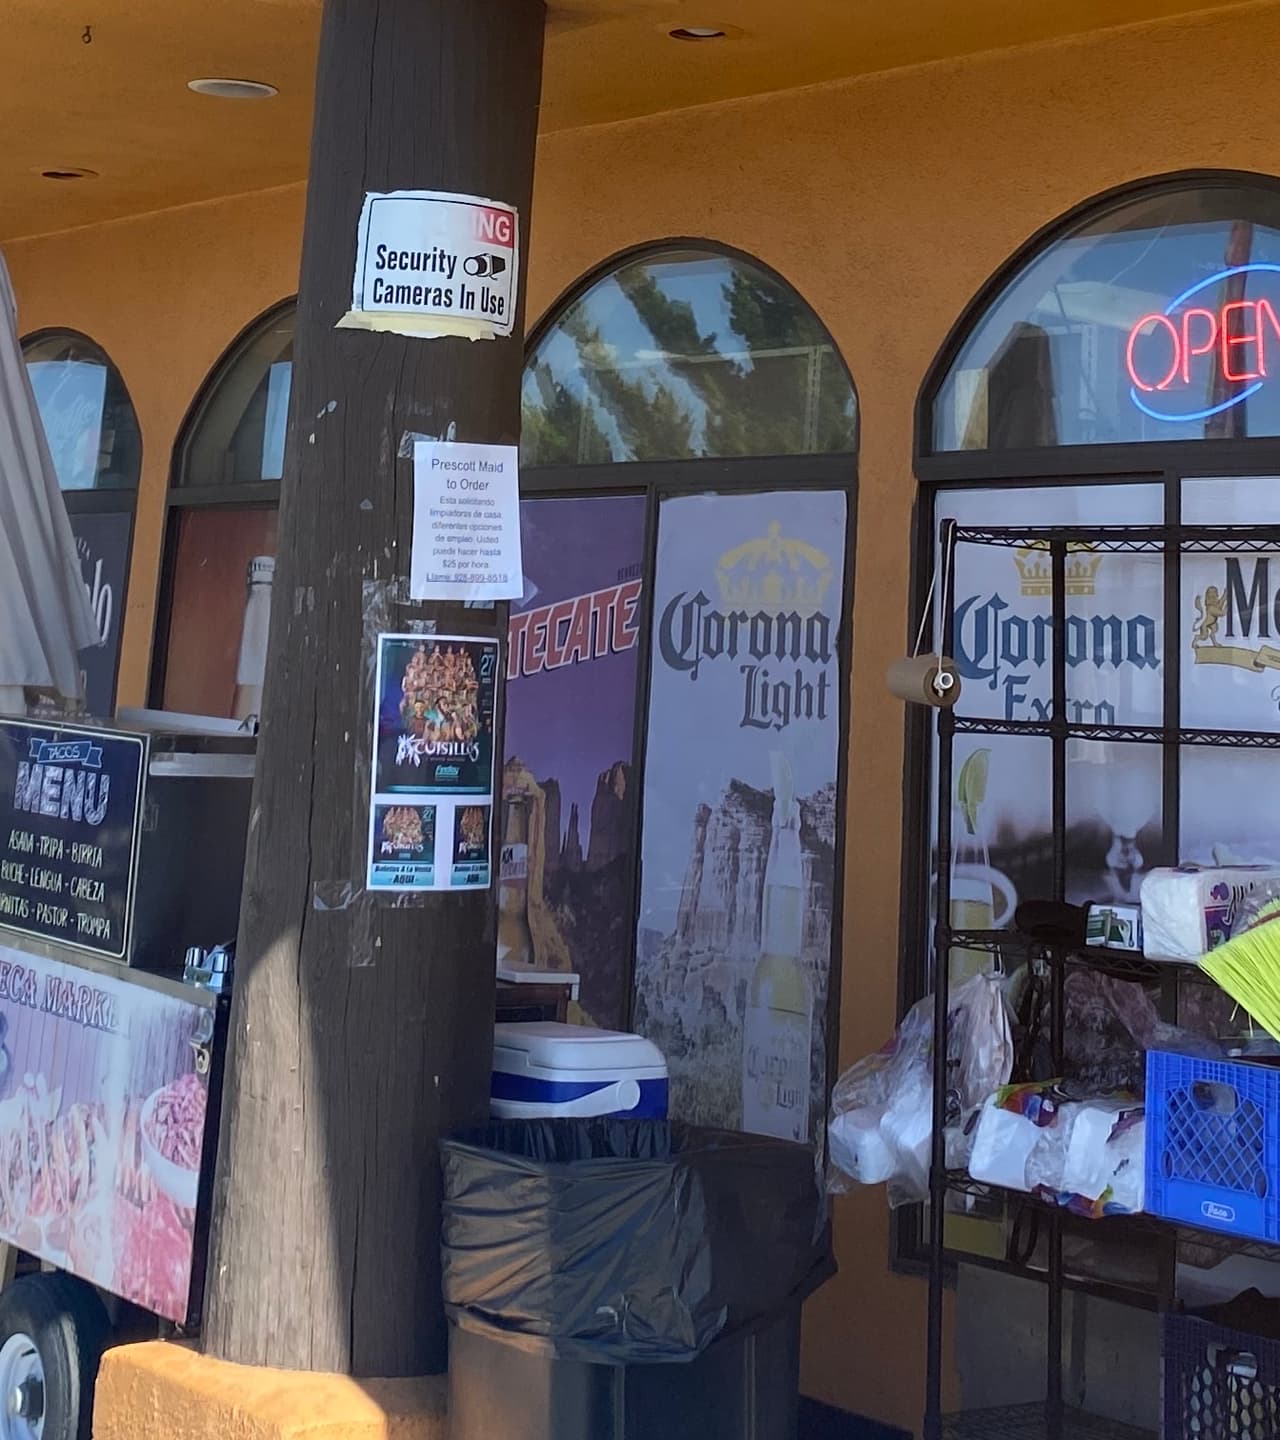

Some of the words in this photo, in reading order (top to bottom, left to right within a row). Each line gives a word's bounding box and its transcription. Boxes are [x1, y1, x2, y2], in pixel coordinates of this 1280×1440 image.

[375, 244, 457, 280] Security
[373, 277, 453, 309] Cameras
[460, 283, 475, 310] In
[481, 288, 505, 316] Use
[431, 458, 476, 472] Prescott
[478, 461, 504, 474] Maid
[446, 478, 457, 490] to
[460, 478, 489, 491] Order
[507, 578, 643, 681] TECATE
[658, 590, 833, 681] Corona
[952, 592, 1161, 691] Corona
[481, 654, 495, 676] 27
[739, 664, 831, 733] Light
[1002, 675, 1116, 726] Exra
[48, 746, 80, 760] TACOS
[14, 761, 110, 826] MENU
[8, 829, 34, 854] ASADA
[39, 836, 64, 861] TRIPA
[71, 842, 103, 869] BIRRIA
[1, 860, 24, 885] BUCHE
[30, 867, 62, 894] LENGUA
[70, 876, 105, 903] CABEZA
[36, 902, 69, 927] PASTOR
[76, 912, 110, 940] TROMPA
[40, 974, 122, 1036] MARKE
